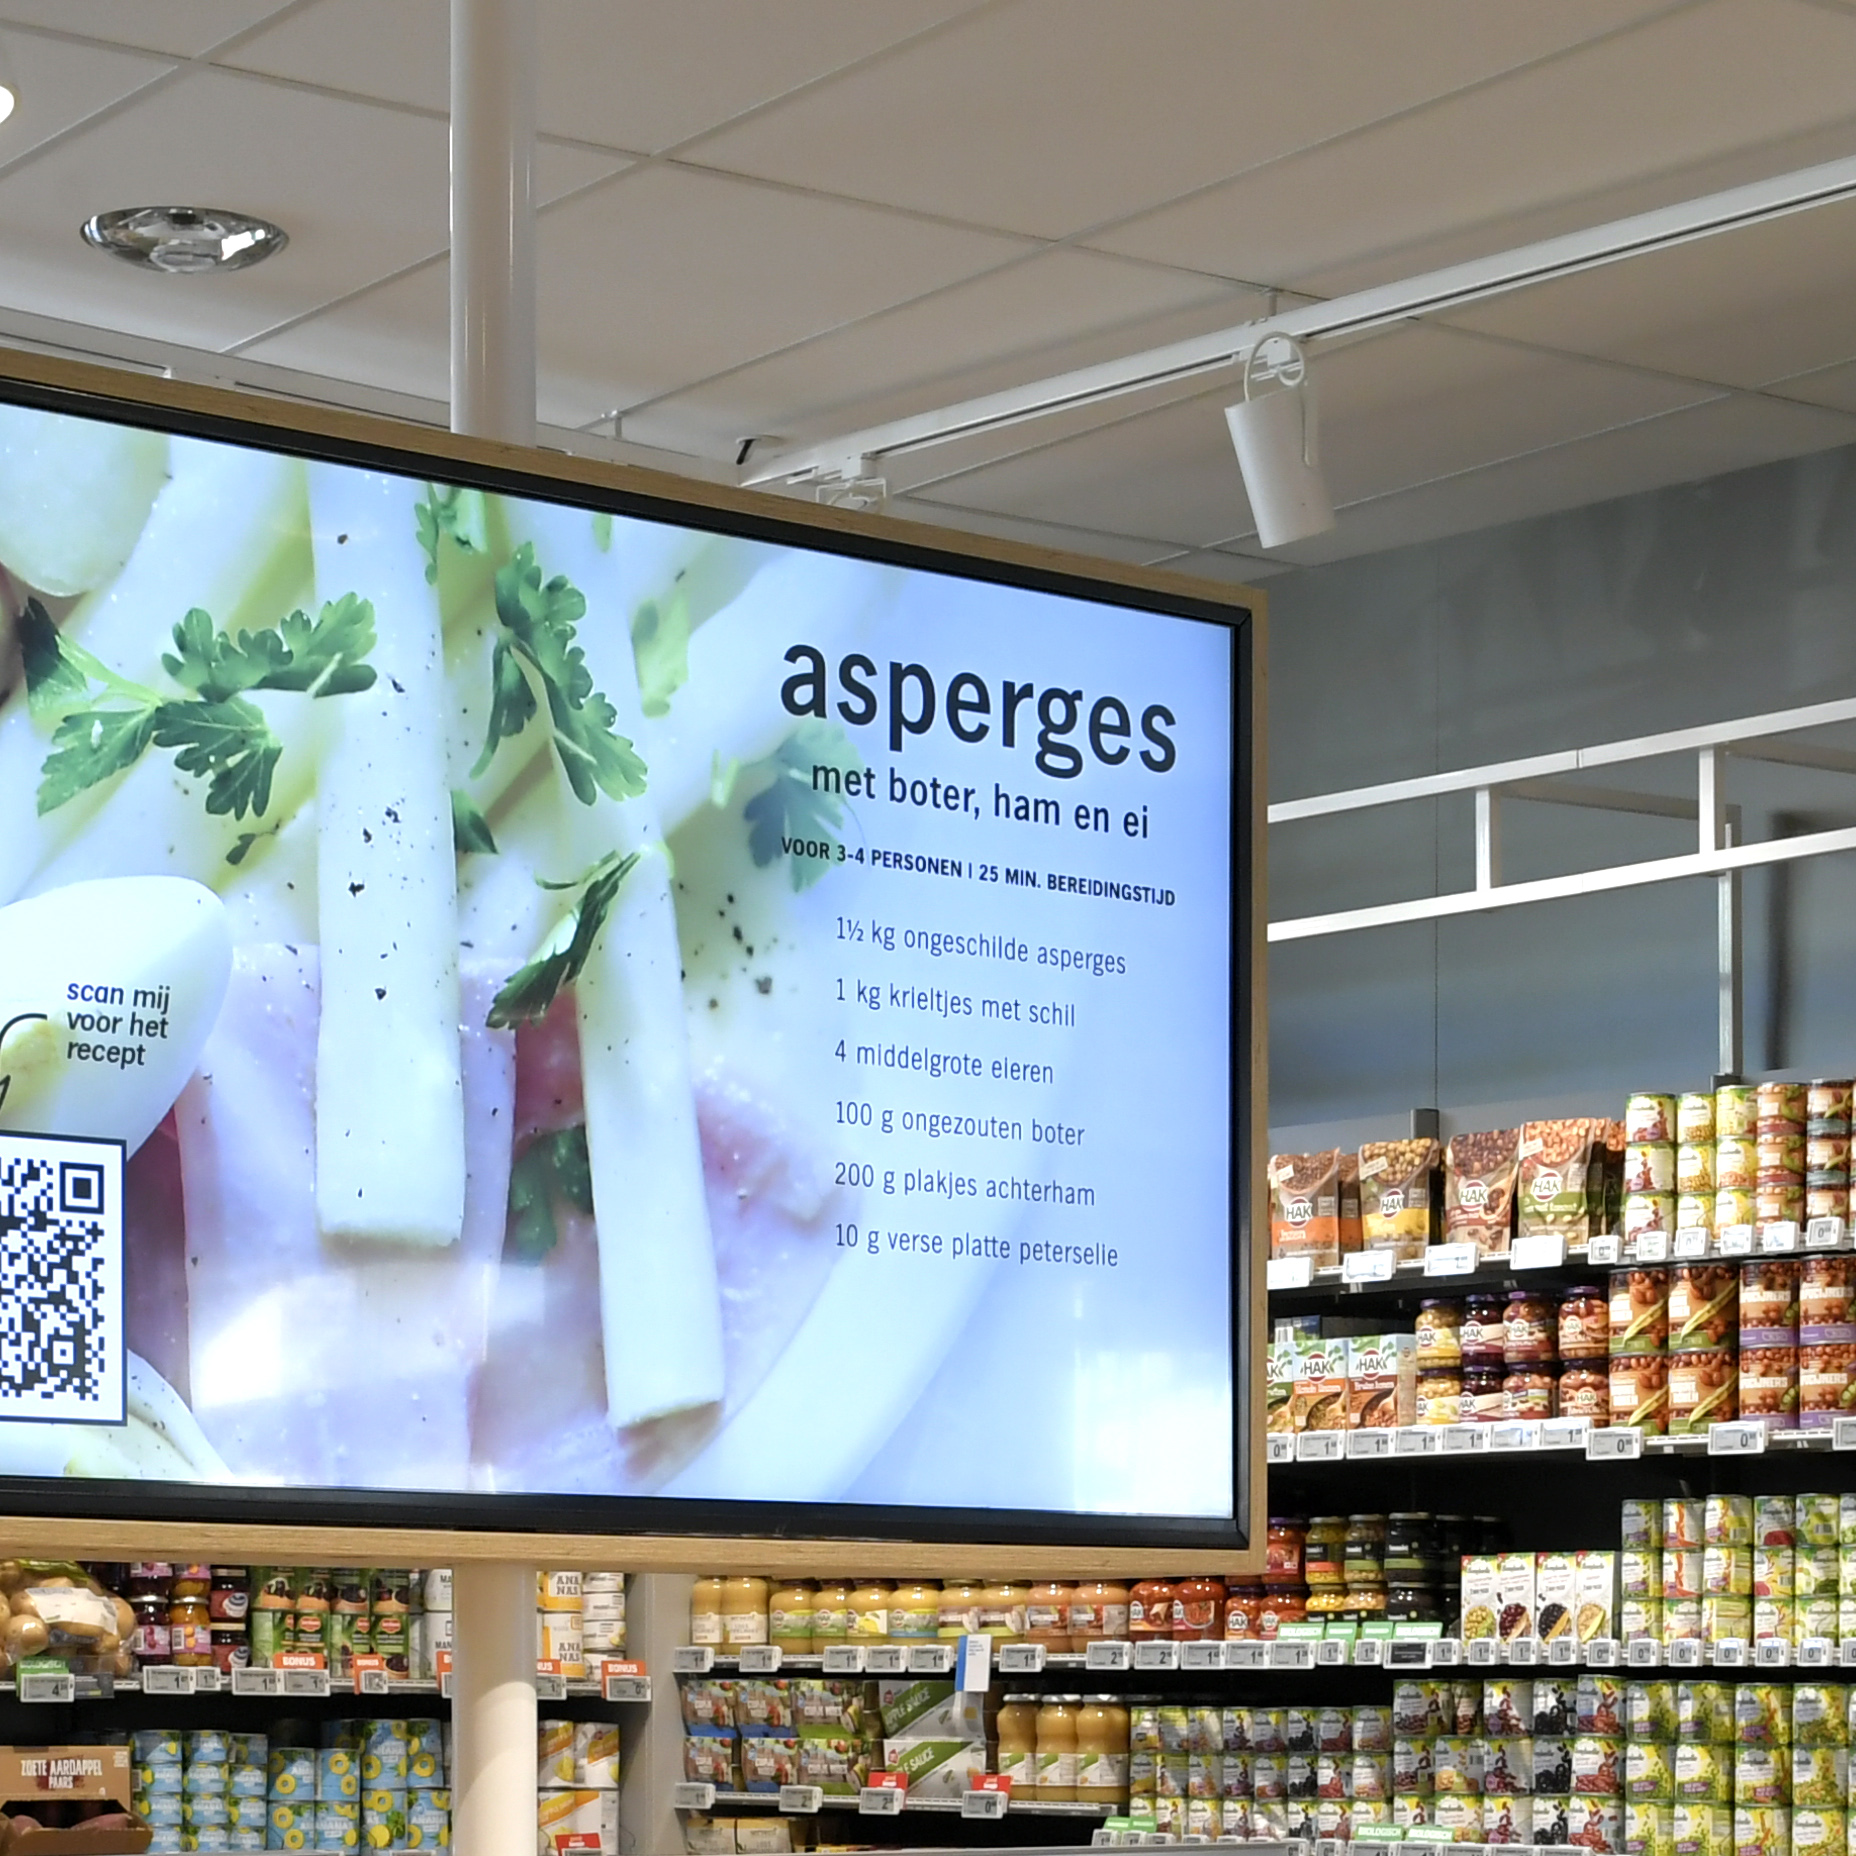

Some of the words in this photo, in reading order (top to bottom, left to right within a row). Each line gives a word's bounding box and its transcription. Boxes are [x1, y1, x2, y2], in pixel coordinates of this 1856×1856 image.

[780, 643, 1178, 777] asperges
[811, 760, 876, 797] met
[888, 763, 981, 822] boter,
[994, 783, 1061, 826] ham
[1074, 804, 1111, 834] en
[1123, 807, 1149, 839] ei
[781, 835, 831, 862] VOOR
[837, 844, 866, 866] 3-4
[871, 848, 963, 879] PERSONEN
[978, 863, 1000, 886] 25
[1005, 866, 1042, 890] MIN.
[1046, 873, 1176, 907] BEREIDINGSTIJD
[837, 916, 865, 943] 1½
[871, 920, 896, 951] kg
[903, 924, 1029, 964] ongeschilde
[1037, 945, 1127, 977] asperges
[67, 983, 124, 1005] scan
[133, 985, 170, 1015] mij
[837, 978, 845, 1002] 1
[856, 982, 882, 1010] kg
[888, 982, 974, 1019] krieltjes
[981, 997, 1021, 1023] met
[1028, 1000, 1076, 1029] schil
[67, 1012, 123, 1034] voor
[130, 1012, 169, 1039] het
[67, 1041, 146, 1070] recept
[834, 1040, 847, 1064] 4
[856, 1040, 983, 1080] middelgrote
[991, 1055, 1054, 1085] eieren
[835, 1101, 872, 1129] 100
[880, 1111, 895, 1135] g
[902, 1109, 1023, 1142] ongezouten
[1031, 1116, 1086, 1148] boter
[834, 1162, 875, 1190] 200
[883, 1172, 896, 1196] g
[903, 1167, 977, 1200] plakjes
[985, 1176, 1095, 1207] achterham
[1532, 1179, 1562, 1194] HAK
[1459, 1188, 1487, 1202] HAK
[1286, 1204, 1312, 1218] HAK
[1381, 1199, 1404, 1212] HAK
[835, 1223, 858, 1249] 10
[867, 1231, 881, 1255] g
[888, 1232, 944, 1257] verse
[951, 1228, 1011, 1262] platte
[1019, 1237, 1119, 1268] peterselie
[1303, 1362, 1330, 1376] HAK
[1359, 1358, 1383, 1370] HAK
[557, 1575, 580, 1585] ANA
[557, 1585, 580, 1595] NAS
[559, 1642, 584, 1652] ANA
[282, 1657, 316, 1667] BONUS
[357, 1658, 380, 1667] BONUS
[560, 1652, 581, 1662] NAS
[607, 1664, 638, 1673] BONUS
[909, 1748, 935, 1770] SAUCE
[21, 1760, 47, 1776] ZOETE
[50, 1759, 102, 1776] AARDAPPEL
[48, 1776, 73, 1789] PAARS
